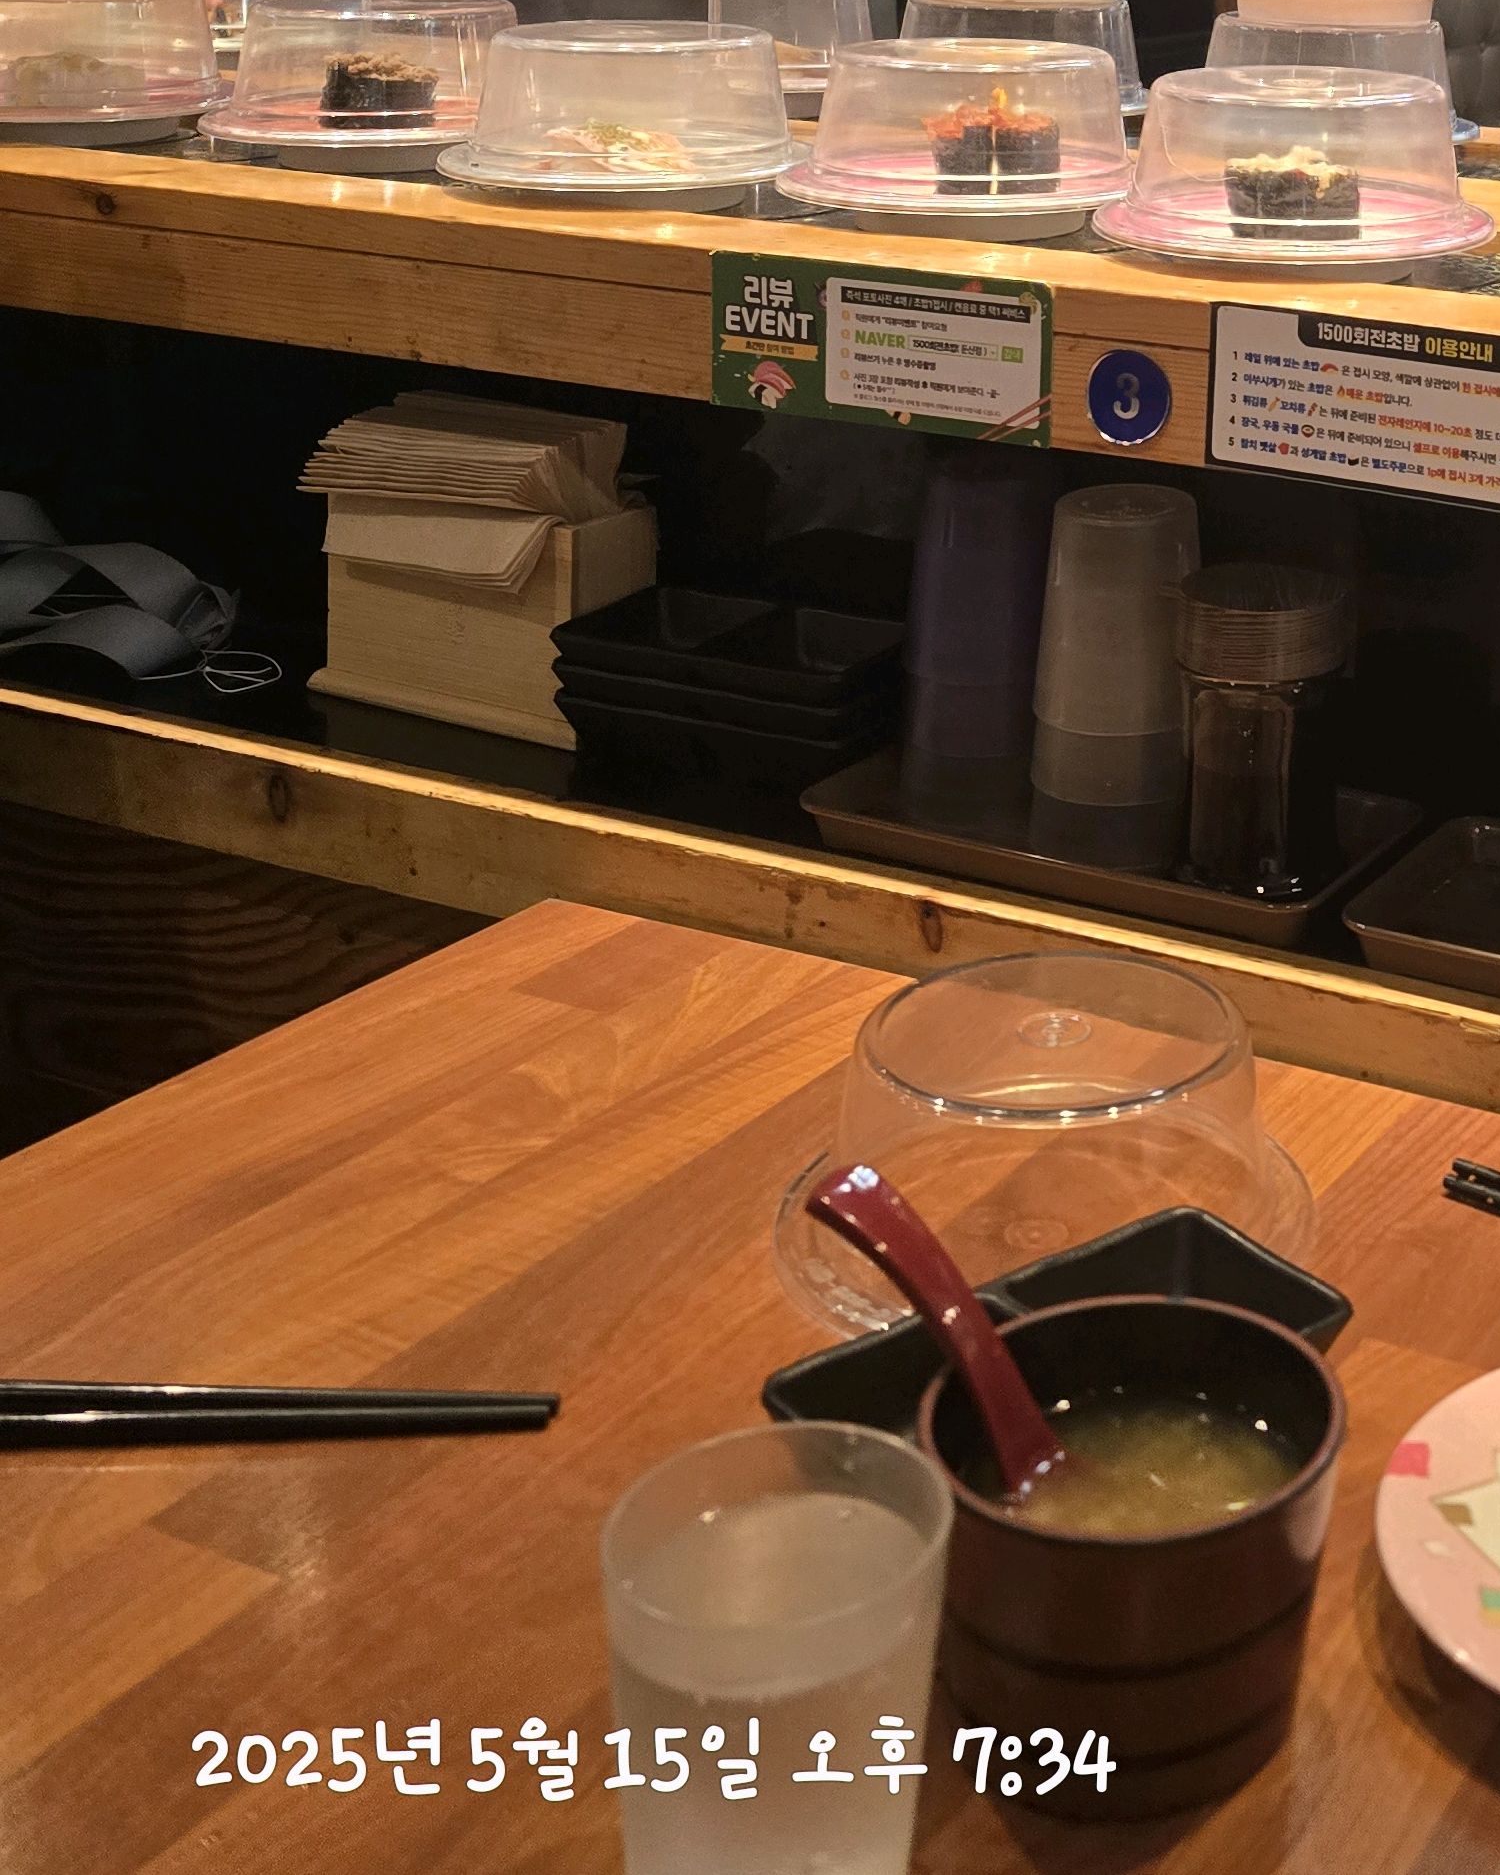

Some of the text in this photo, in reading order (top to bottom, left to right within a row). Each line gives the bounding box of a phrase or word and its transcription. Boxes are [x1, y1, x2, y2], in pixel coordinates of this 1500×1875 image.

[743, 275, 794, 309] 리뷰
[725, 304, 814, 340] EVENT
[855, 329, 906, 349] NAVER
[1317, 322, 1494, 363] 1500회전초밥 이용안내
[1353, 366, 1371, 379] 접시
[1112, 371, 1141, 420] 3
[1350, 410, 1376, 425] 준비된
[1475, 428, 1494, 442] 정도
